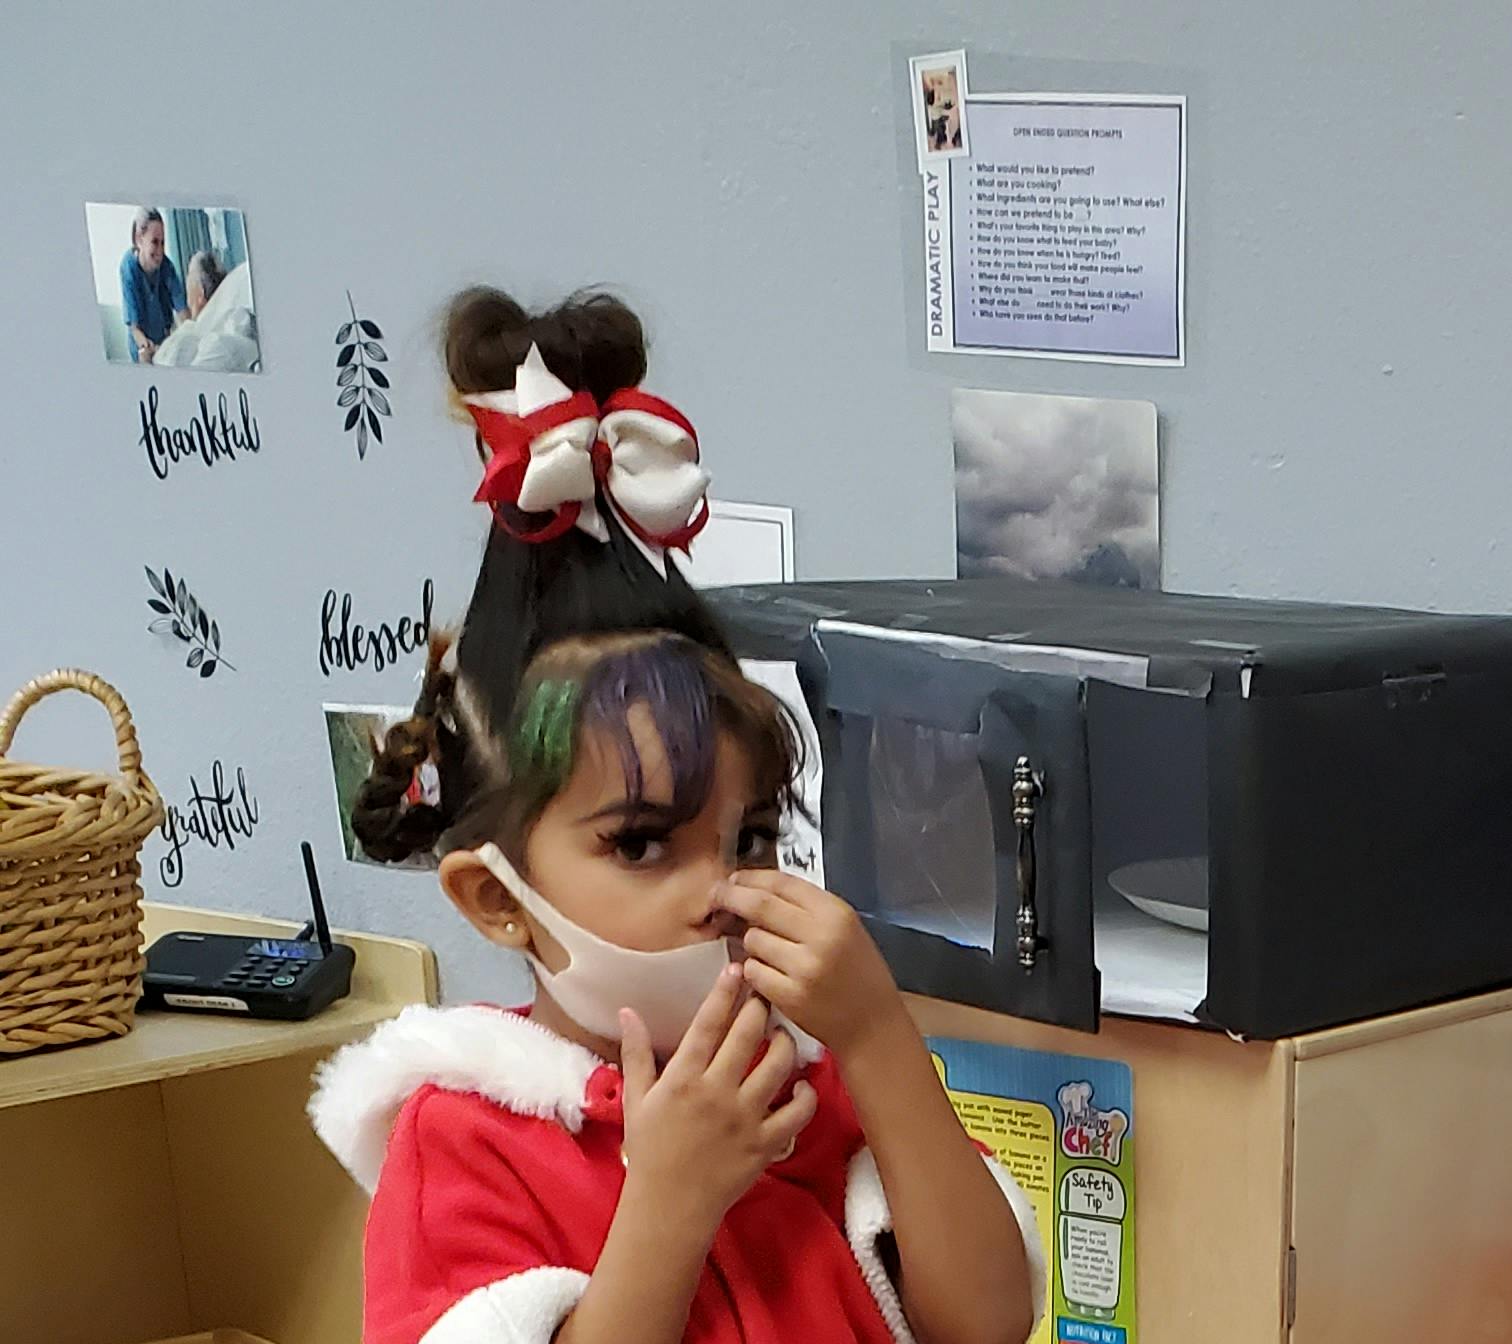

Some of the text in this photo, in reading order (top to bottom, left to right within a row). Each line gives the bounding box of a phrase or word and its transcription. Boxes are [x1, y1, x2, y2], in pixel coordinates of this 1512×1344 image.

[1013, 127, 1031, 137] OPEN
[977, 164, 1095, 176] What would you like to pretend?
[977, 178, 1061, 192] What are you cooking?
[977, 192, 995, 201] What
[1052, 197, 1067, 205] you
[1069, 196, 1091, 208] going
[1092, 195, 1101, 205] to
[1102, 196, 1120, 206] use?
[1122, 196, 1143, 207] What
[976, 208, 993, 216] How
[994, 209, 1008, 217] can
[1023, 209, 1053, 219] pretend
[926, 170, 943, 337] DRAMATIC PLAY
[139, 385, 261, 480] thankful
[319, 578, 435, 677] blessed
[159, 759, 259, 888] grateful
[1064, 1127, 1113, 1158] Chef
[1071, 1172, 1114, 1201] Safety
[1083, 1192, 1102, 1214] Tip
